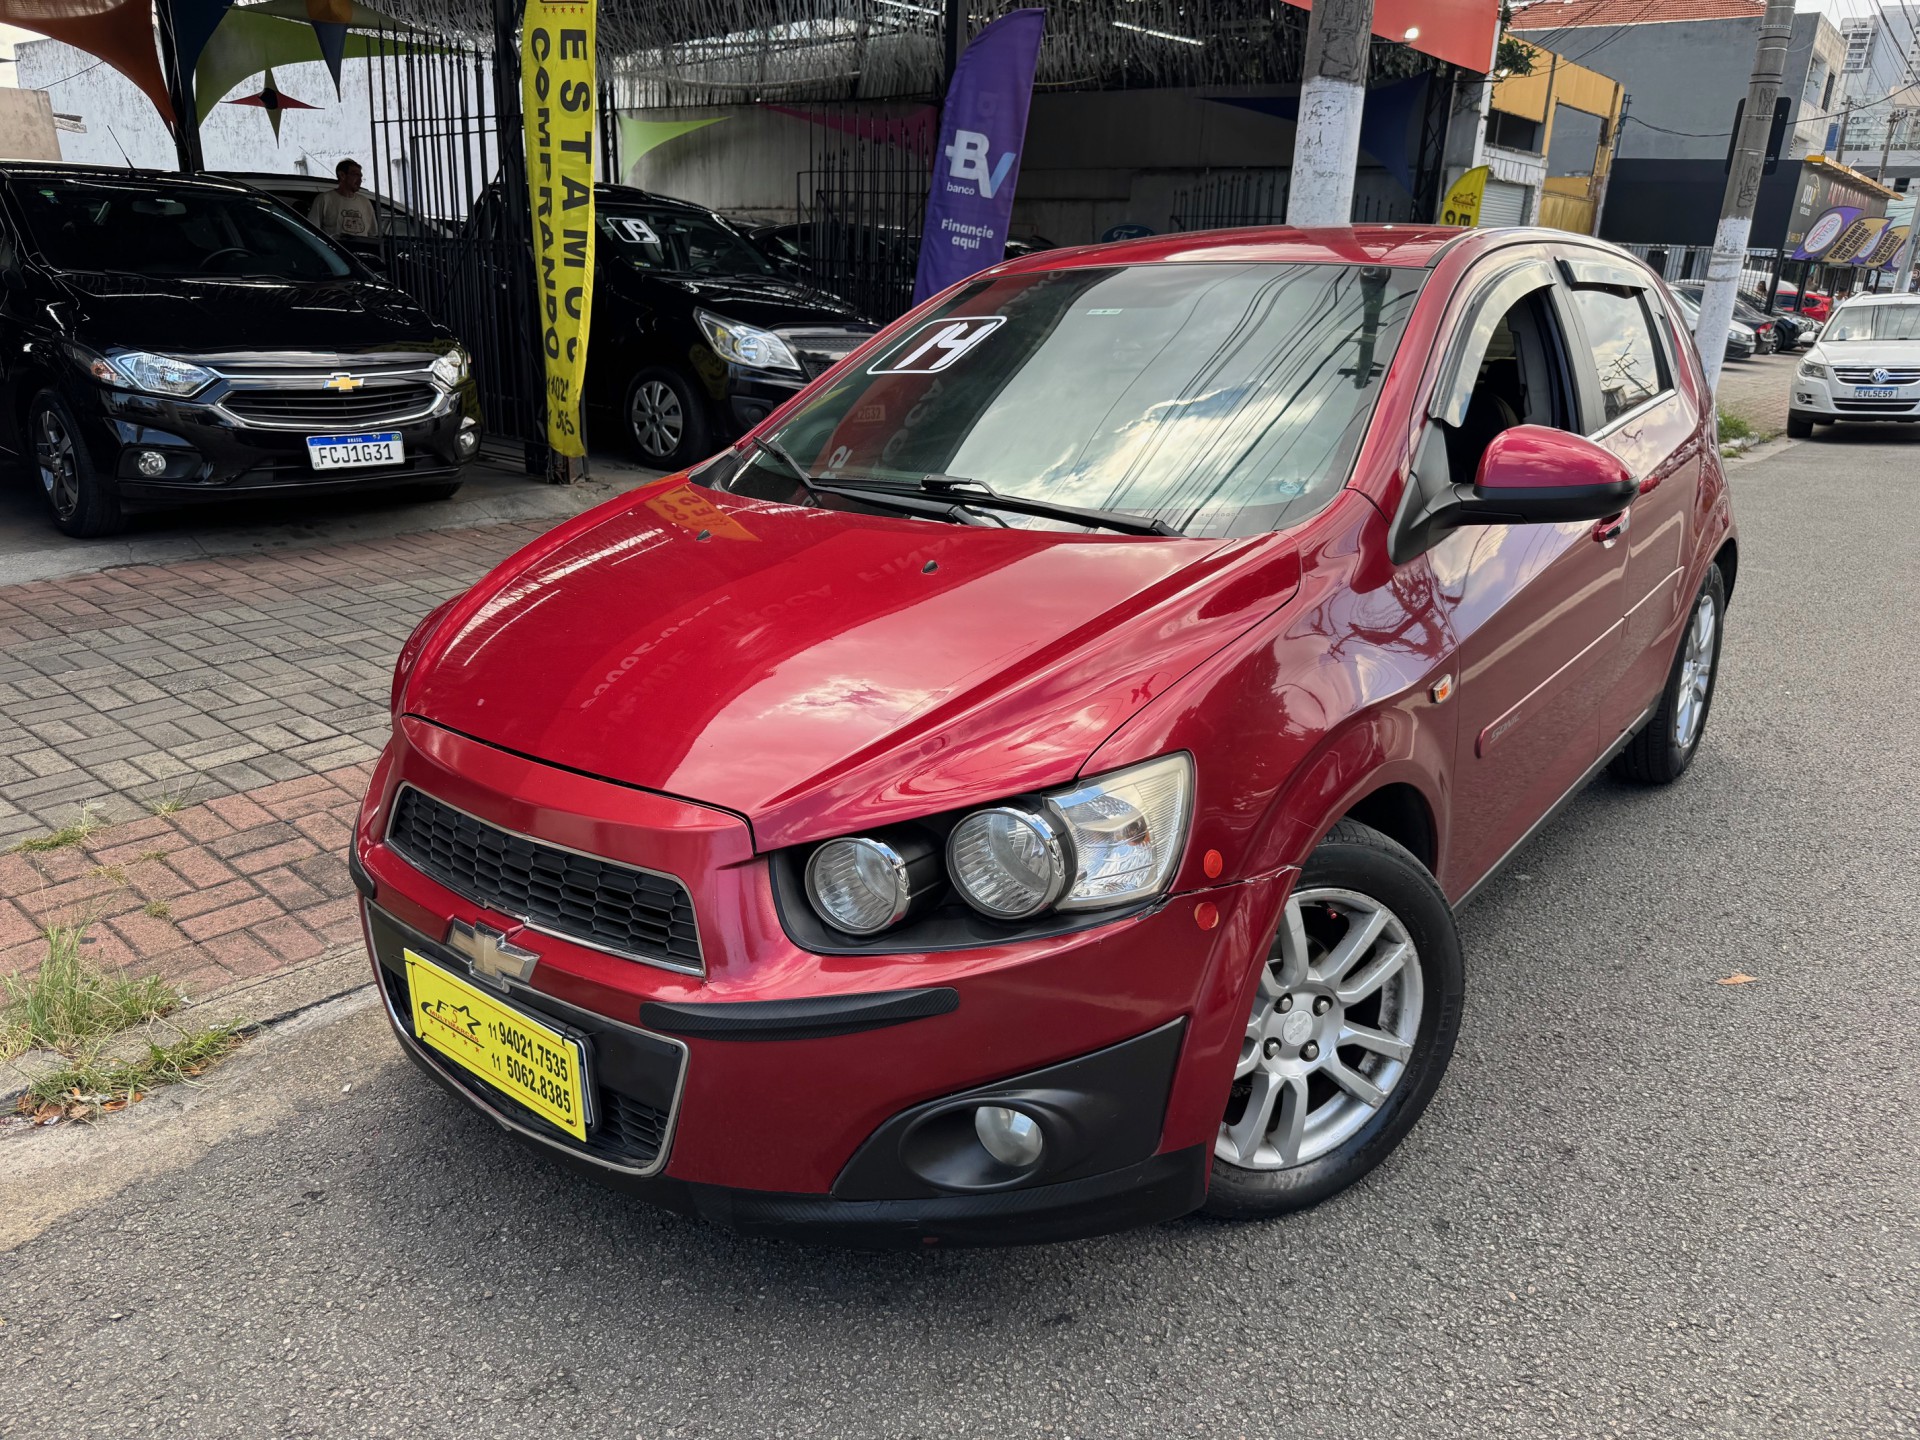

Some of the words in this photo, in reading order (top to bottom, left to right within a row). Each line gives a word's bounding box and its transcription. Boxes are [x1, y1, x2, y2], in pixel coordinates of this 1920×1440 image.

[945, 129, 1016, 199] BV
[531, 27, 559, 361] COMPRANDO
[947, 182, 975, 196] banco
[941, 218, 994, 239] Financie
[951, 235, 980, 250] aqui
[1829, 220, 1865, 259] COMPRAMOS
[1838, 248, 1851, 261] SEU
[893, 321, 998, 370] 14
[318, 443, 394, 465] FCJ1G31
[430, 1009, 480, 1043] MULTIMARCAS
[488, 1022, 498, 1041] 11
[499, 1021, 568, 1082] 94021.7535
[491, 1053, 501, 1071] 11
[506, 1055, 571, 1114] 5062.8385
